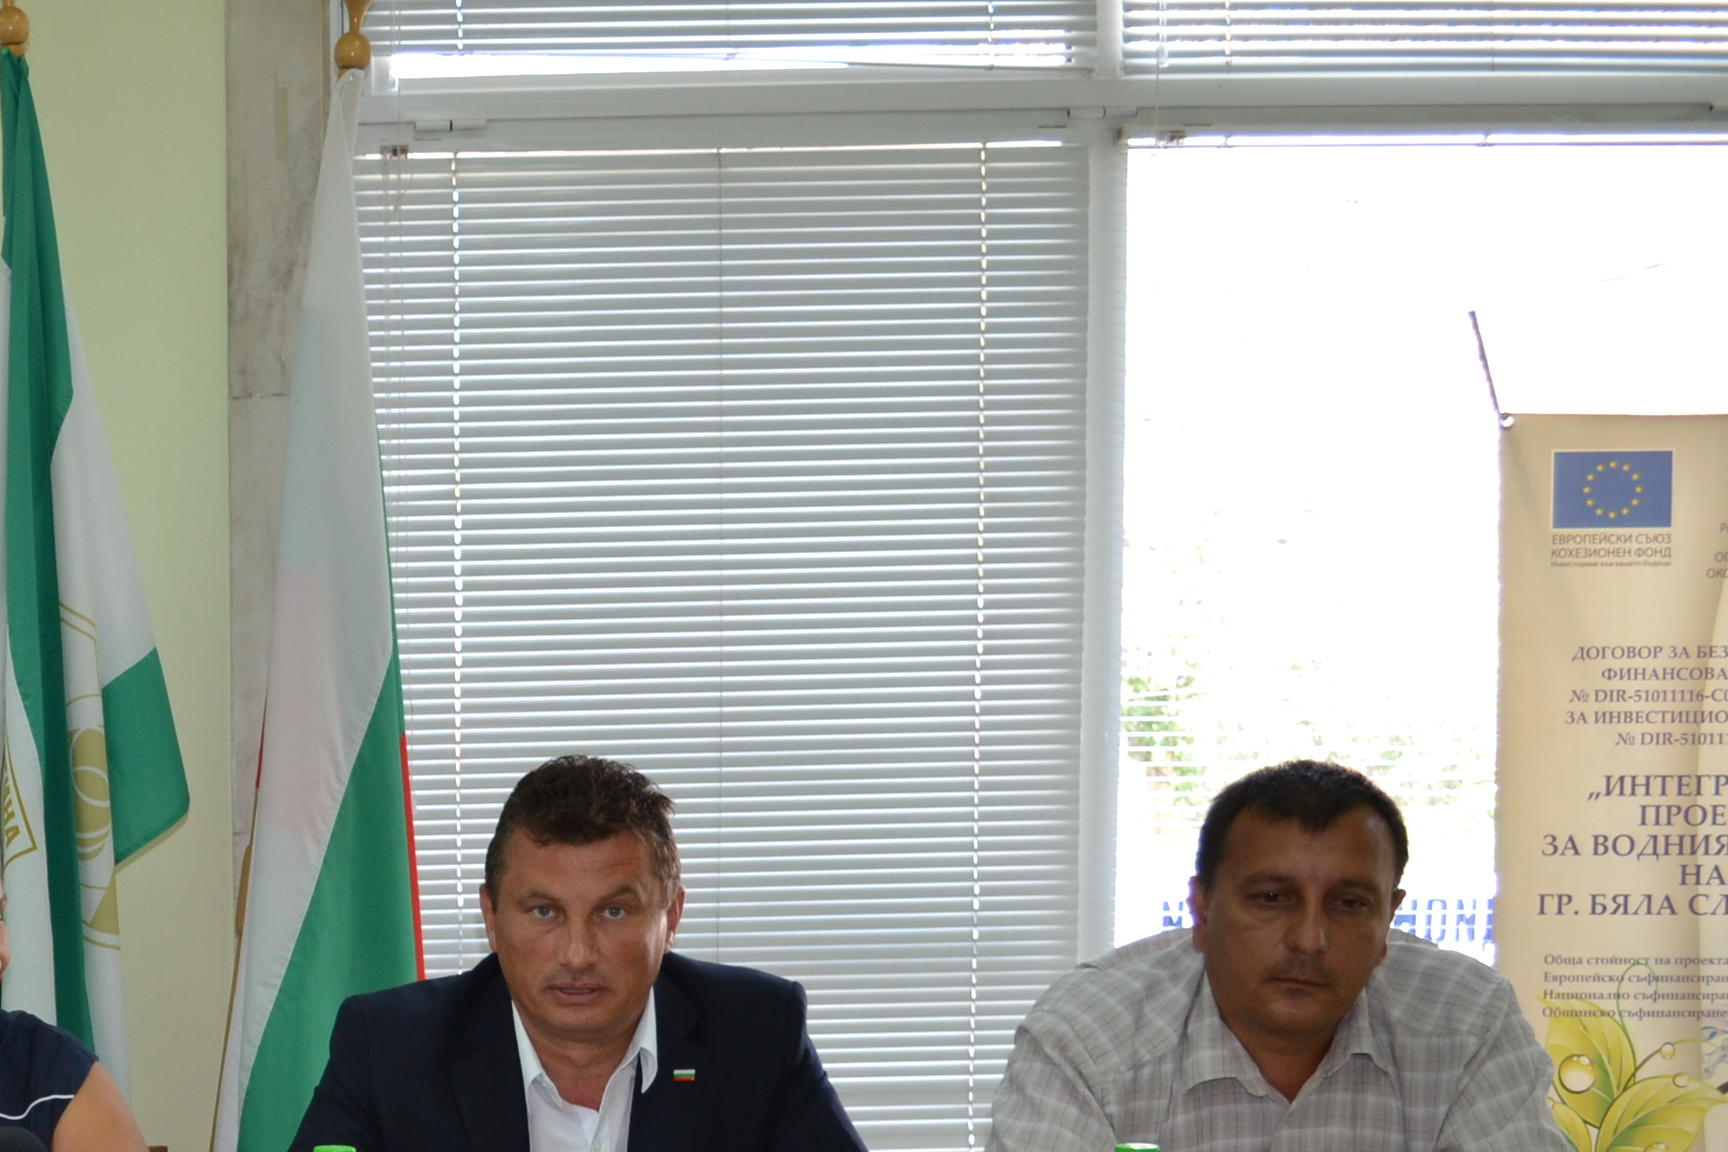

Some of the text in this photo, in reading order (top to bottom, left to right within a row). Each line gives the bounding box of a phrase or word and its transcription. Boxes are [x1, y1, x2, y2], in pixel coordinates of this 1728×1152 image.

[1552, 532, 1672, 546] ЕВРОПЕЙСКИ СЪЮЗ
[1551, 546, 1672, 560] КОХЕЗИОНЕН ФОНД
[1572, 645, 1728, 662] ДОГОВОР ЗА БЕЗ
[1601, 666, 1728, 681] ФИНАНСОВА
[1569, 689, 1589, 704] №
[1565, 709, 1728, 726] ЗА ИНВЕСТИЦИО
[1615, 732, 1635, 747] №
[1638, 804, 1727, 827] ПРОЕ
[1541, 833, 1728, 862] ЗА ВОДНИЯ
[1679, 863, 1728, 887] НА
[1537, 893, 1728, 917] ГР. БЯЛА СЛ
[1544, 953, 1728, 969] Обща стойност на проекта
[1544, 970, 1625, 985] Европейско
[1543, 988, 1630, 1001] Национално
[1542, 1006, 1615, 1020] Общинско
